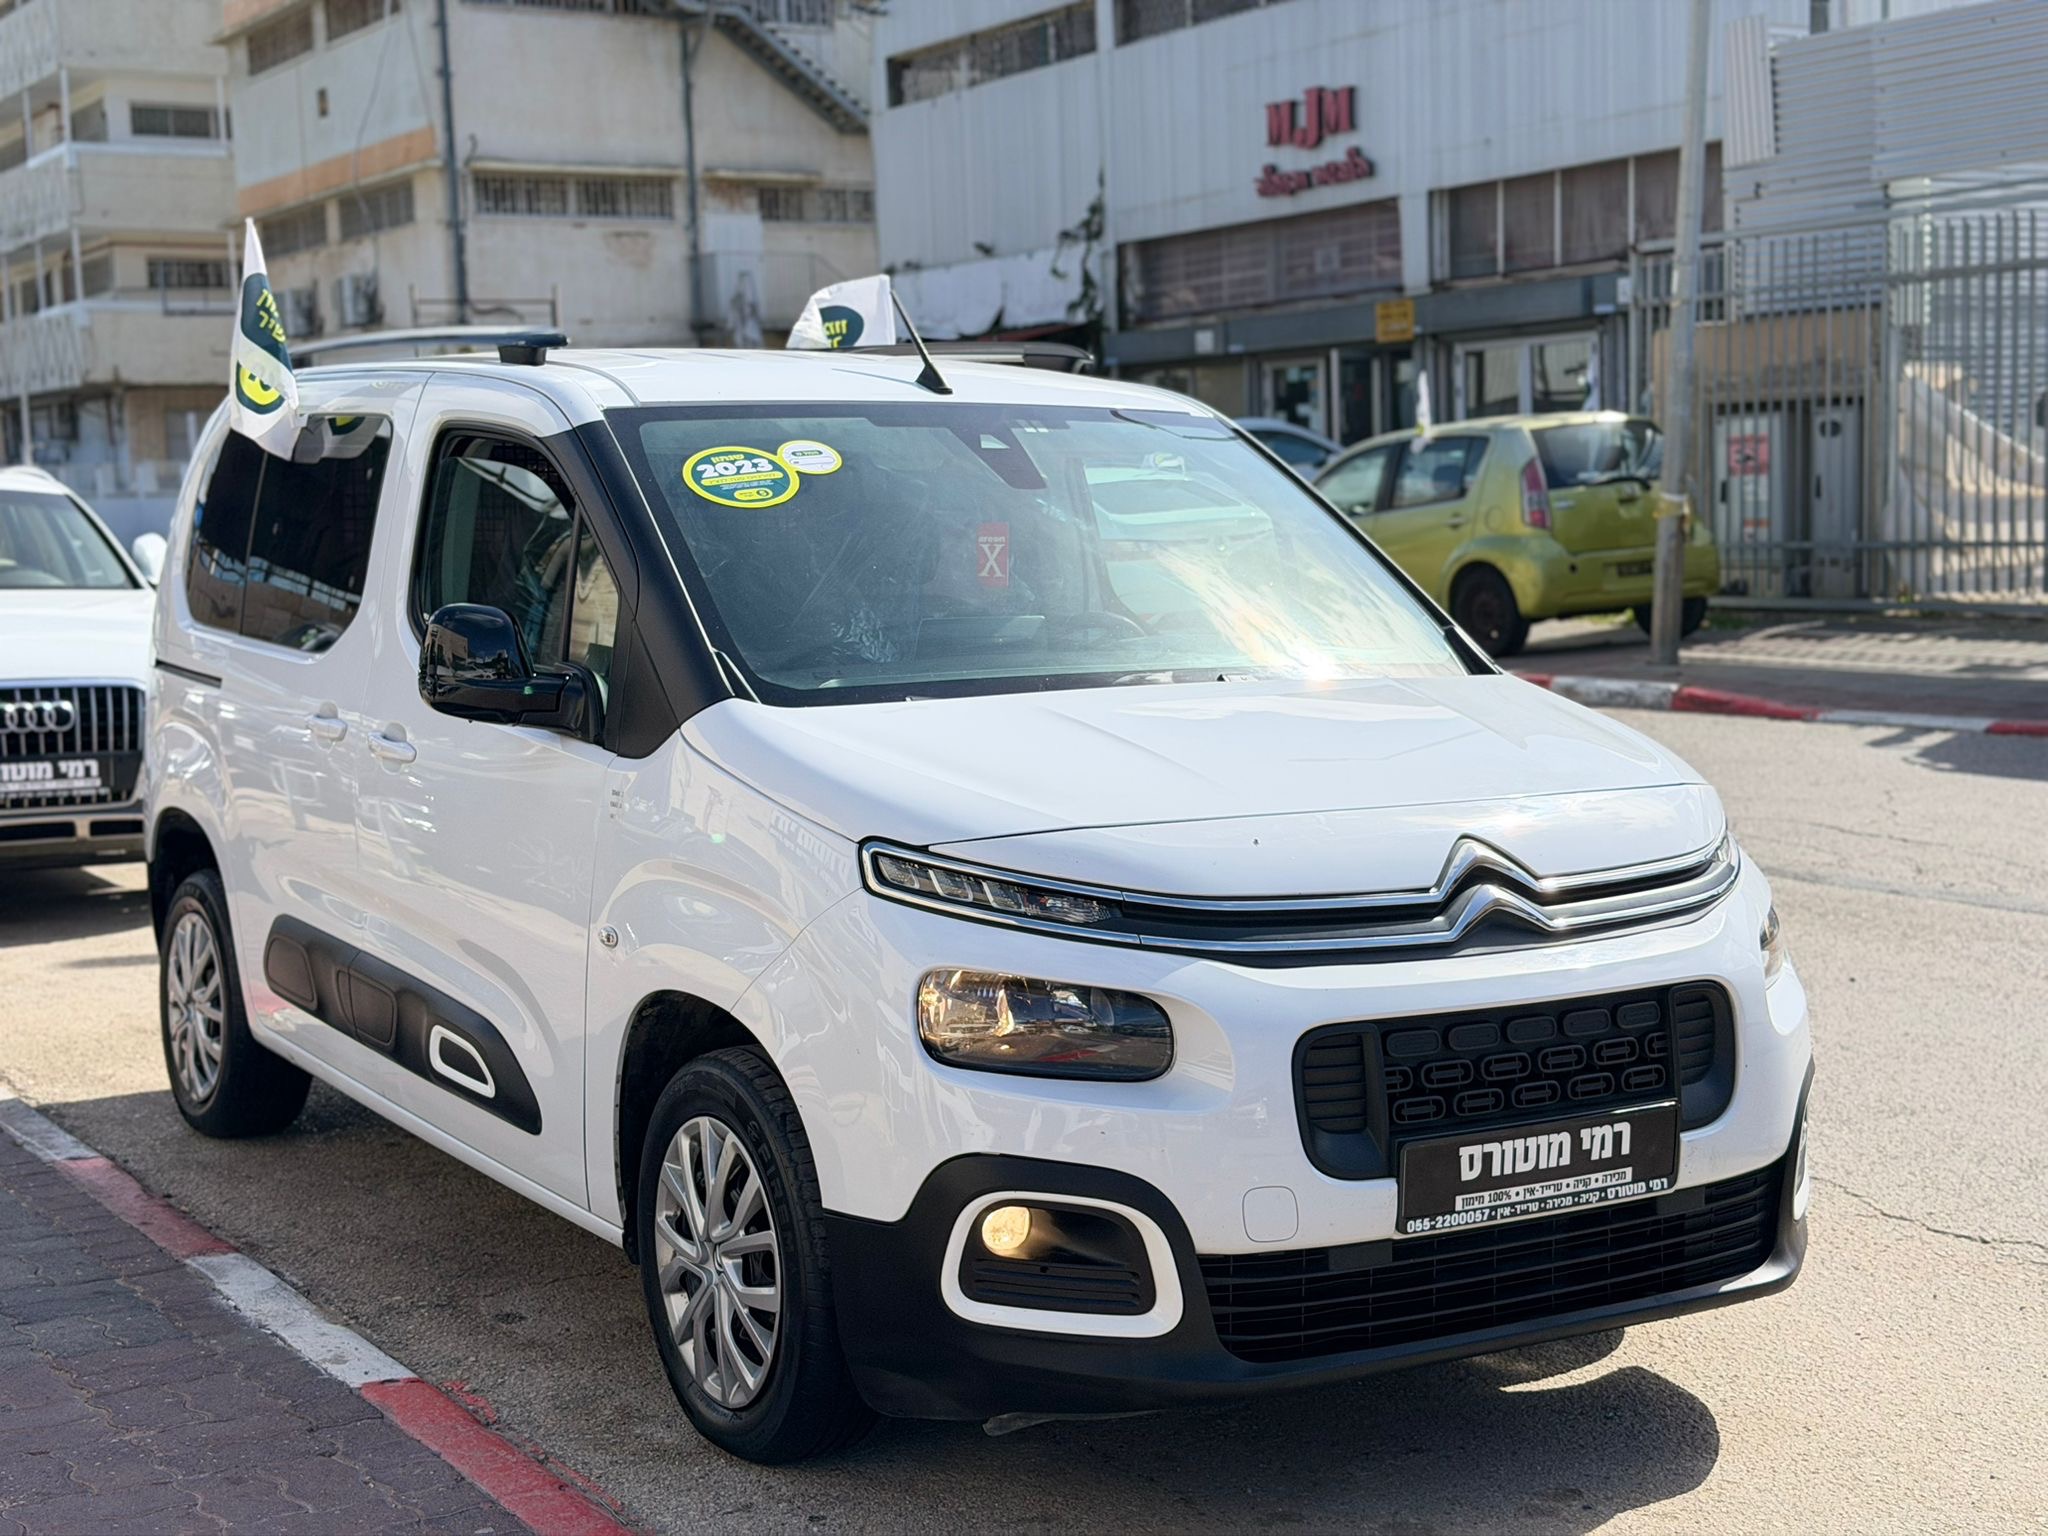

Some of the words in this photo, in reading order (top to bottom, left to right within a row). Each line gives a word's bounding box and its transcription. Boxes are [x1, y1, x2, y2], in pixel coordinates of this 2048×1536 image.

[1266, 86, 1355, 149] MJM
[696, 458, 774, 479] 2023
[978, 543, 1005, 577] X
[0, 761, 54, 781] מוטו
[58, 758, 99, 778] רמי
[1580, 1121, 1631, 1161] רמי
[1458, 1131, 1572, 1182] מוטורס
[1573, 1177, 1592, 1189] קניה
[1601, 1170, 1627, 1184] מכירה
[1649, 1177, 1669, 1191] רמי
[1487, 1190, 1512, 1204] 100%
[1522, 1182, 1563, 1199] טרייד-אין
[1579, 1191, 1600, 1204] קניה
[1607, 1181, 1647, 1199] מוטורס
[1461, 1194, 1485, 1209] מימון
[1496, 1201, 1540, 1220] טרייד-אין
[1546, 1195, 1573, 1209] מכירה
[1406, 1208, 1490, 1233] 055-2200057
